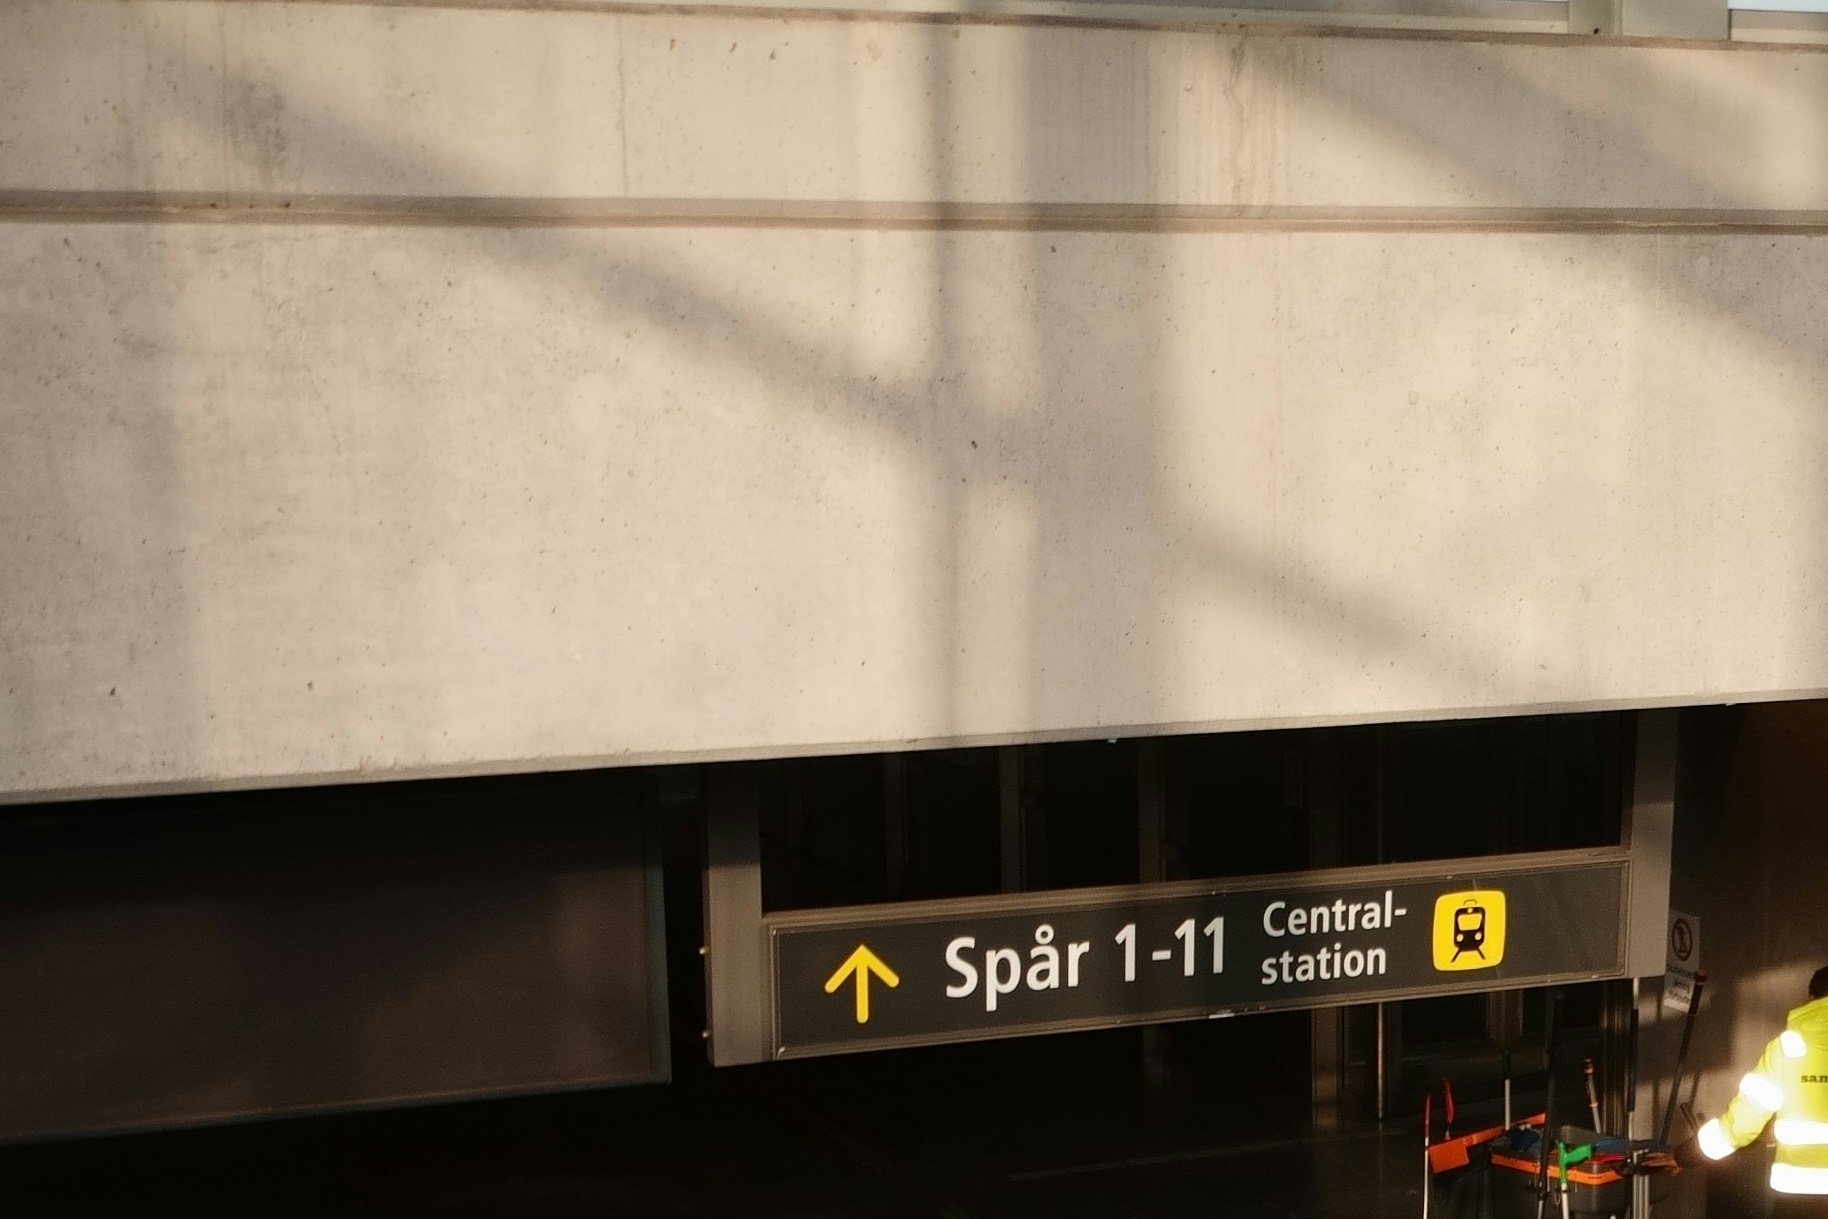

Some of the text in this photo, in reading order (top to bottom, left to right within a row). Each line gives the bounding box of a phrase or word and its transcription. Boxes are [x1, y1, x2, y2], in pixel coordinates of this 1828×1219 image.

[1262, 890, 1407, 939] Central-
[944, 916, 1225, 1012] Spår 1-11
[1260, 942, 1387, 986] station
